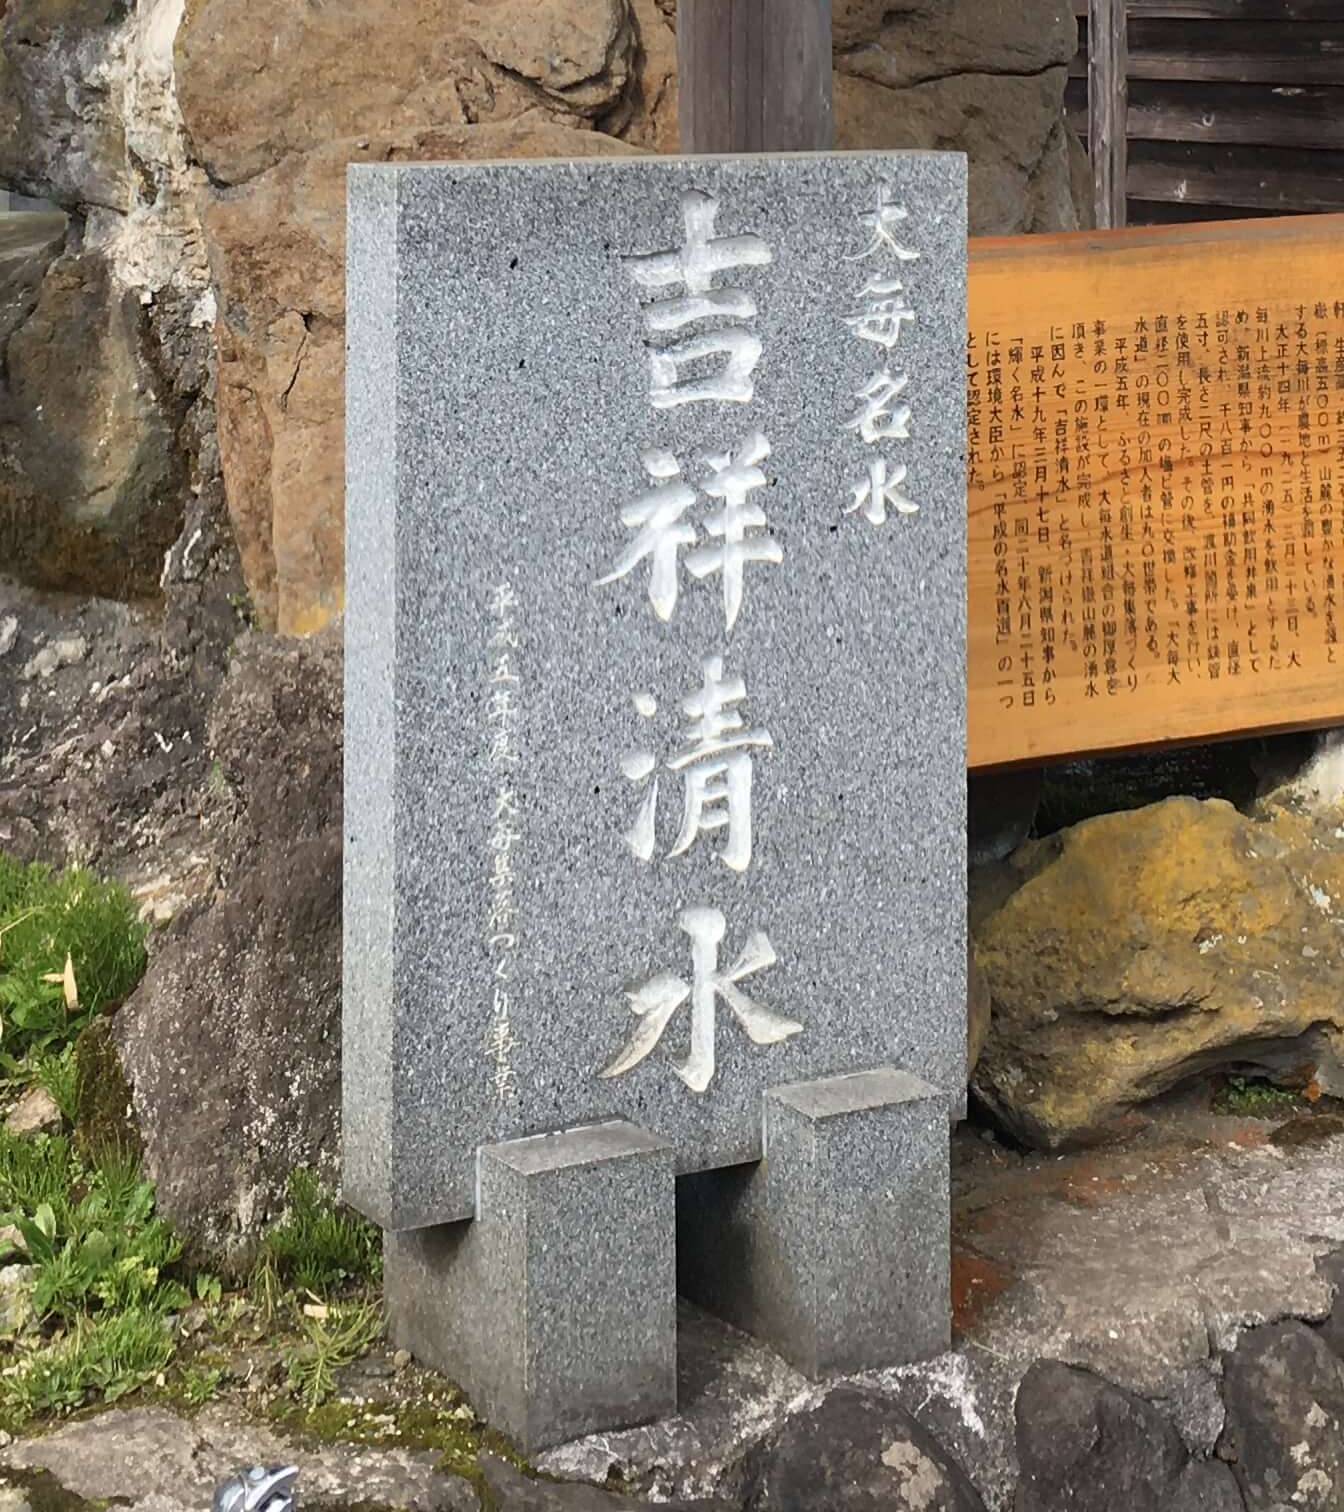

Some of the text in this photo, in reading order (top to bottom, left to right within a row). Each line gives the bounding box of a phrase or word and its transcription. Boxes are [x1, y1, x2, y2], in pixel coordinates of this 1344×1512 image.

[593, 189, 805, 1095] 吉祥清水
[843, 183, 920, 527] 大毎名水
